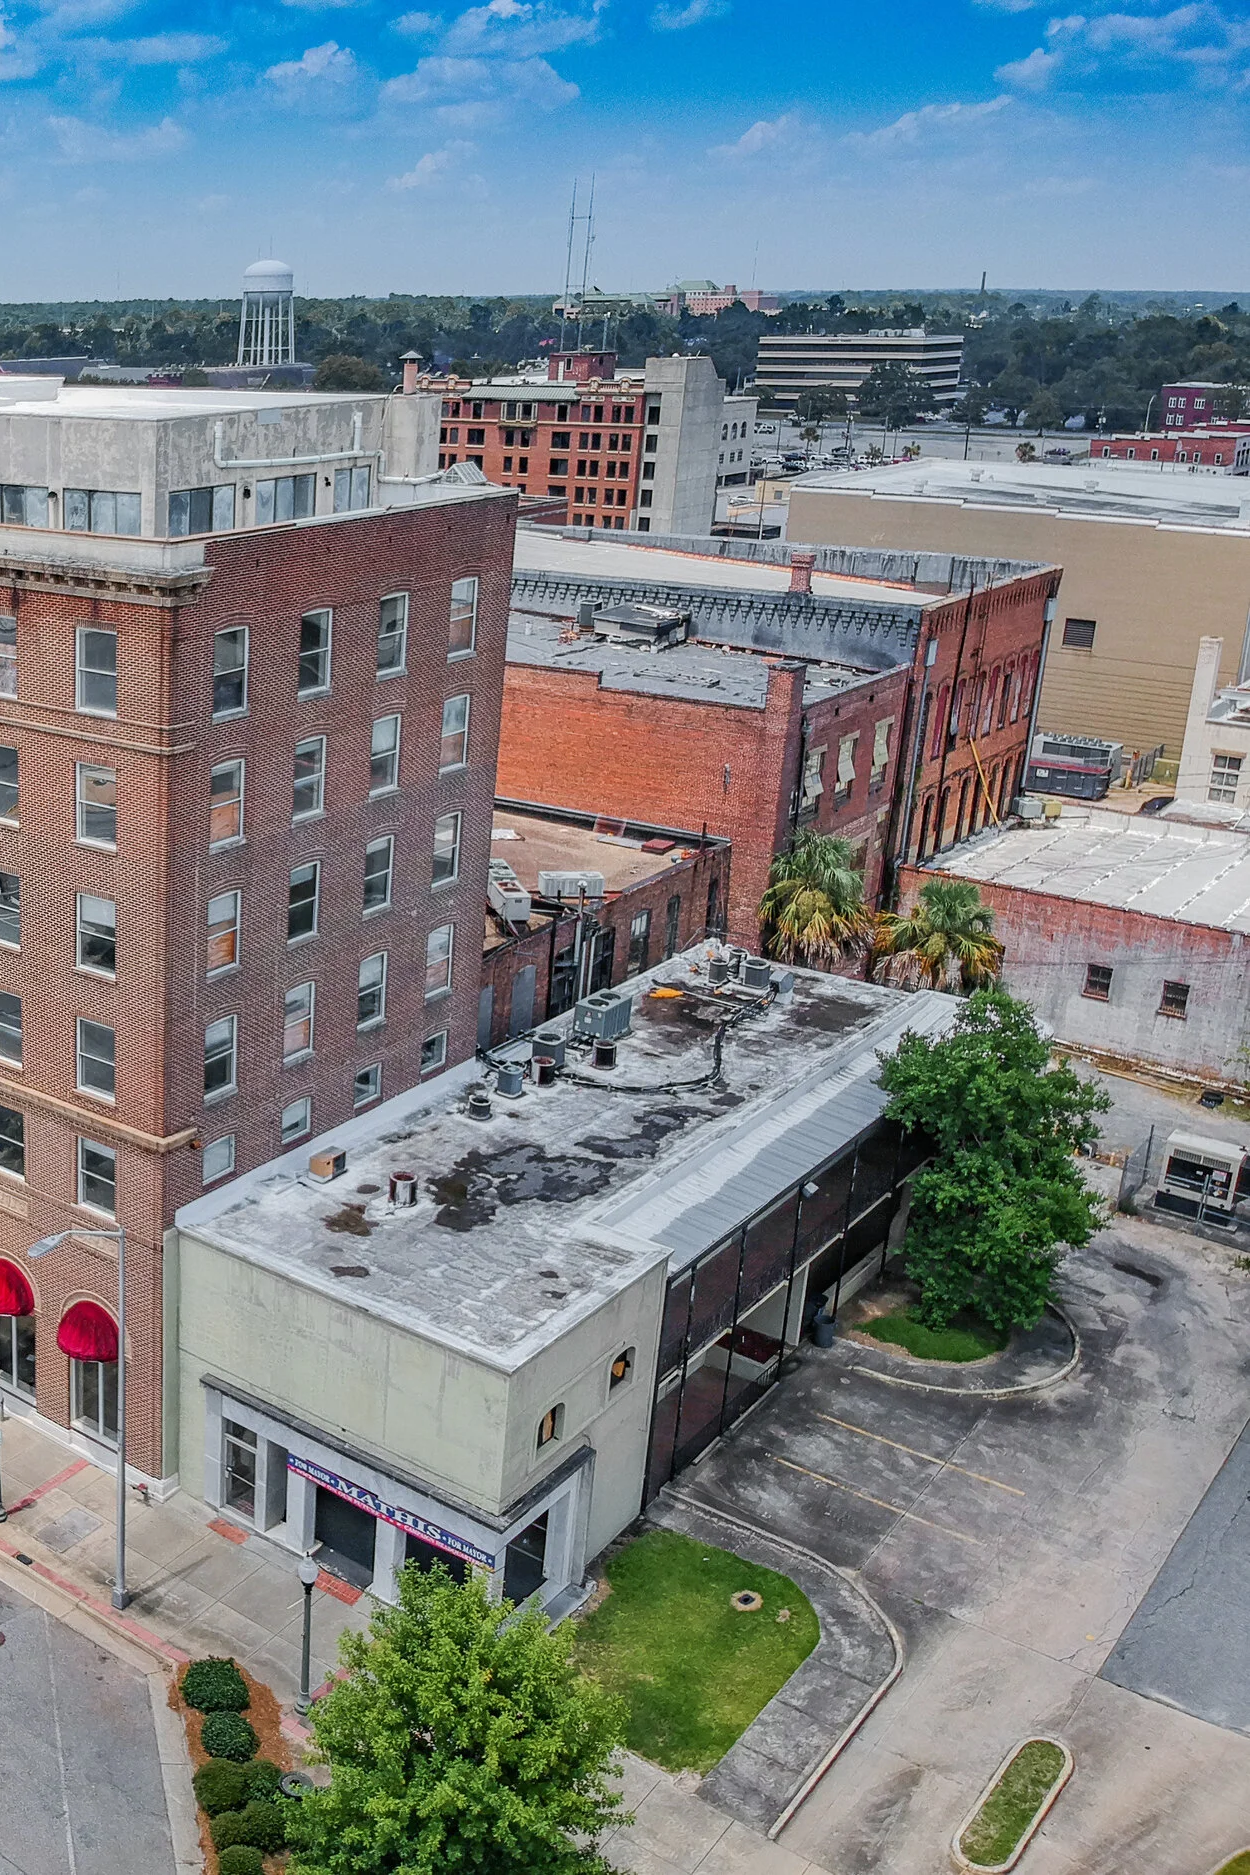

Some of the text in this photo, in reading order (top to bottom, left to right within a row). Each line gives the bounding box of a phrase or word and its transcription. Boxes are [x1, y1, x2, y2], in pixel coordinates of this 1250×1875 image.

[336, 1479, 441, 1540] MATHIS
[447, 1537, 461, 1551] FOR
[462, 1545, 488, 1563] MAYOR
